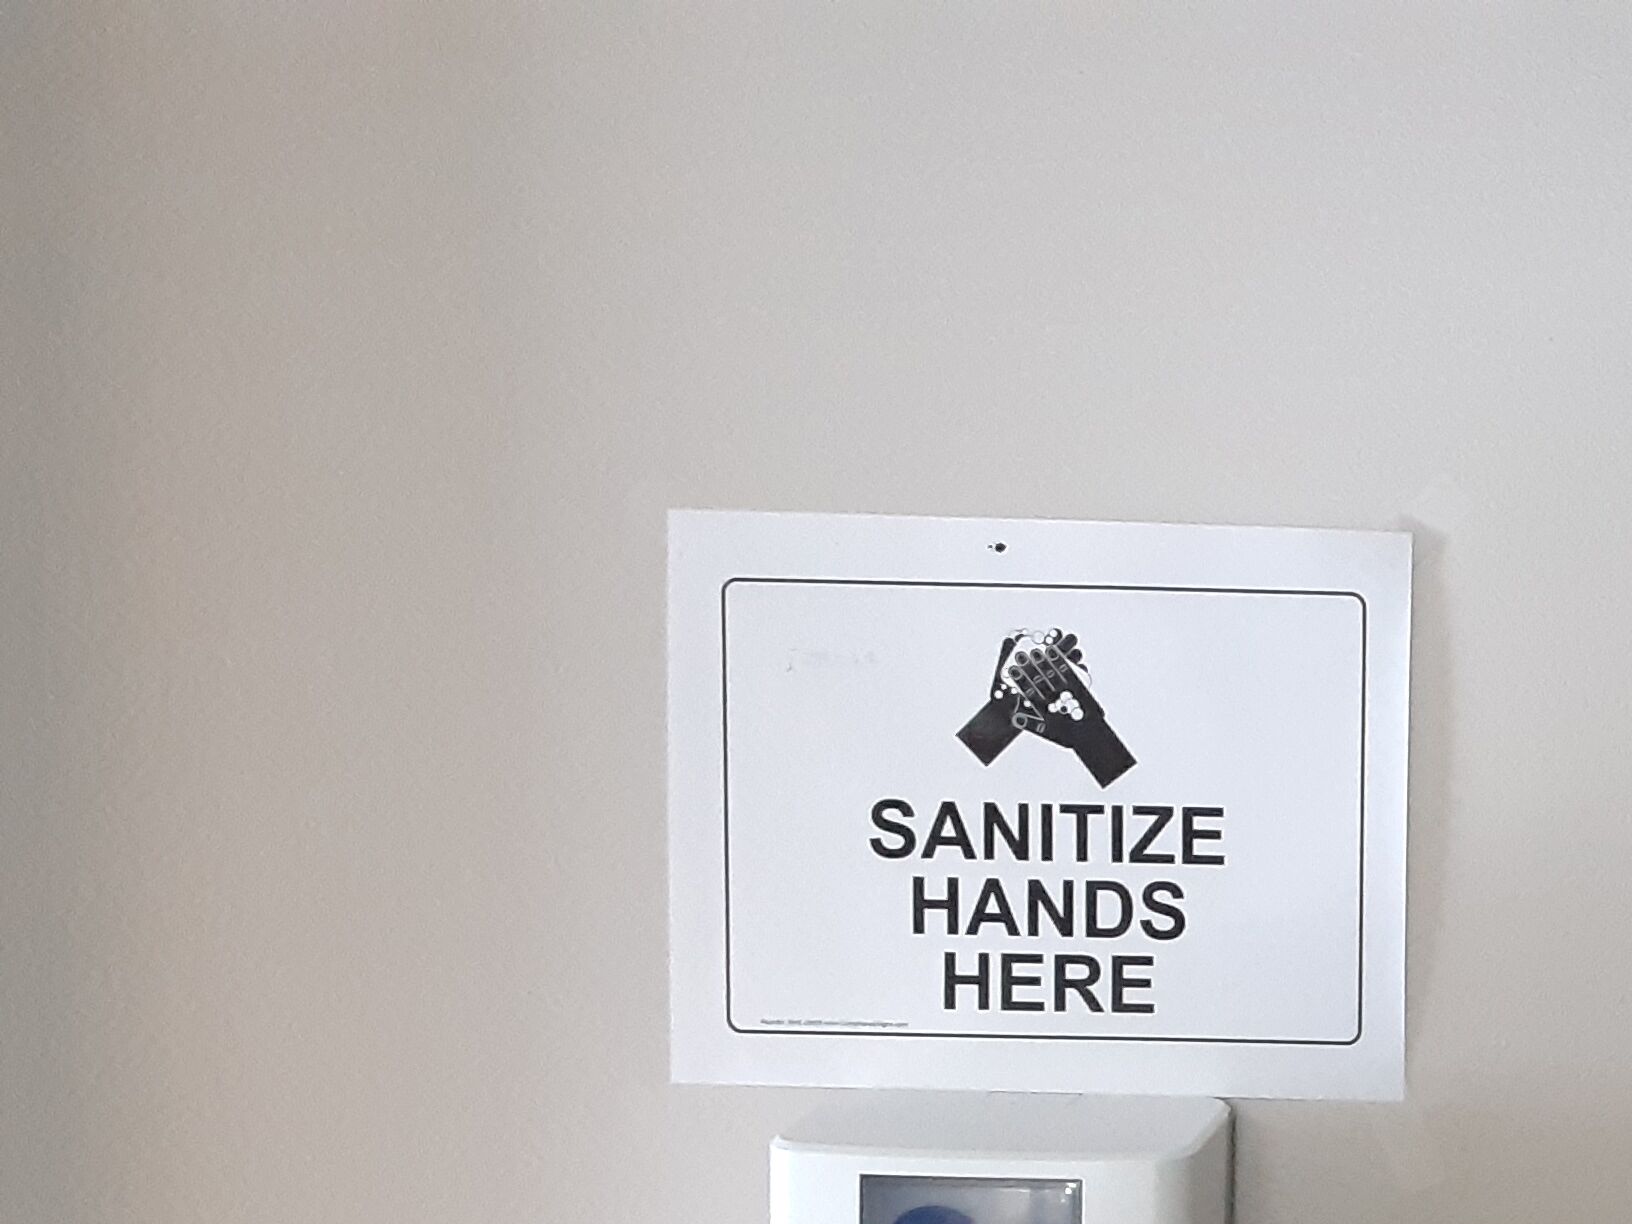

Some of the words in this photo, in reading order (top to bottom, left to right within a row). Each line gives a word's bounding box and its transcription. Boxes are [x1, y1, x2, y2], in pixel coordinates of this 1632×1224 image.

[869, 799, 1226, 866] SANITIZE
[912, 876, 1187, 941] HANDS
[944, 951, 1156, 1014] HERE
